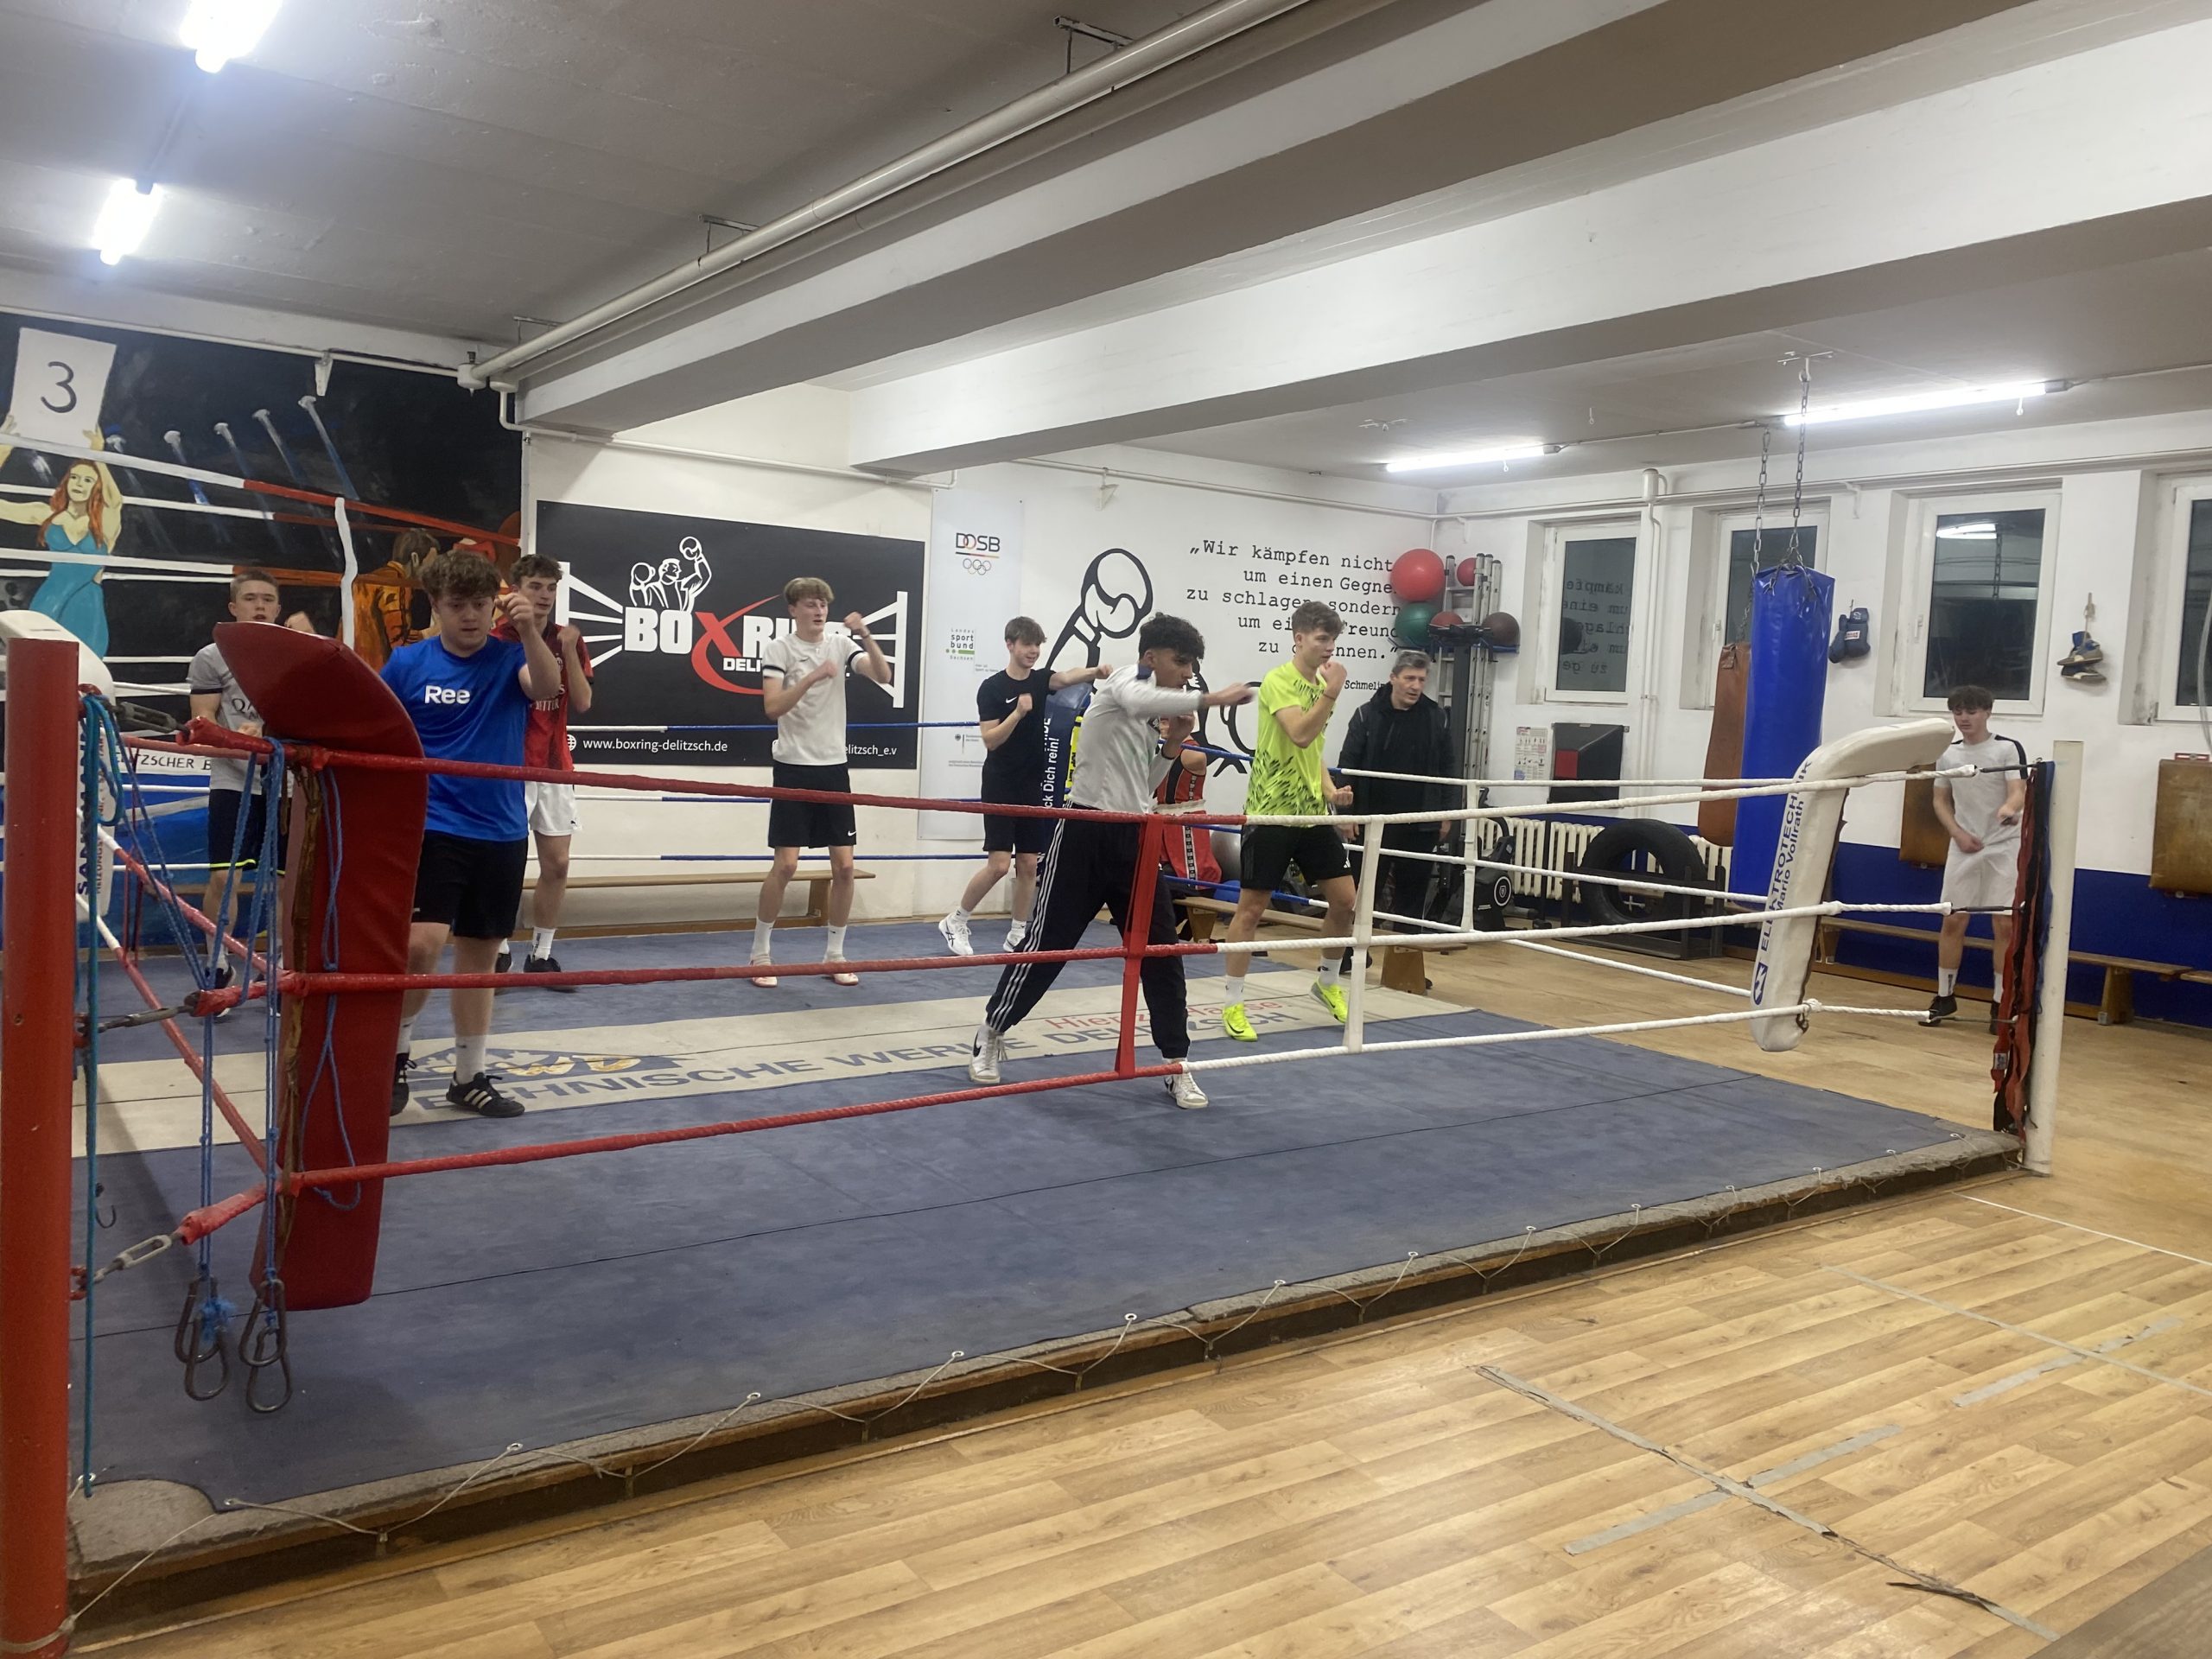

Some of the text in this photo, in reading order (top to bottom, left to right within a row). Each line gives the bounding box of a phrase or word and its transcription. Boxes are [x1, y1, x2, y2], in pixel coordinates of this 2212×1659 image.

[40, 360, 78, 413] 3
[956, 532, 1001, 553] DOSB
[1251, 544, 1330, 566] kämpfen
[1340, 555, 1394, 572] nicht
[1243, 570, 1397, 594] um einen Gegne
[1186, 588, 1209, 601] zu
[1329, 601, 1401, 615] sondern
[1237, 617, 1261, 628] um
[1340, 620, 1397, 638] reun
[950, 641, 974, 650] bund
[1258, 642, 1279, 653] zu
[424, 684, 471, 704] Ree
[582, 737, 898, 757] www.boxring-delitzsch.de elitzsch_e.v
[1046, 738, 1060, 764] rein!
[1043, 766, 1057, 792] Dich
[1761, 761, 1813, 951] ELKTROTECHIK
[1776, 800, 1805, 911] Mario Vollrath
[413, 1059, 823, 1110] EHNISCHE
[825, 1038, 1038, 1067] WERE
